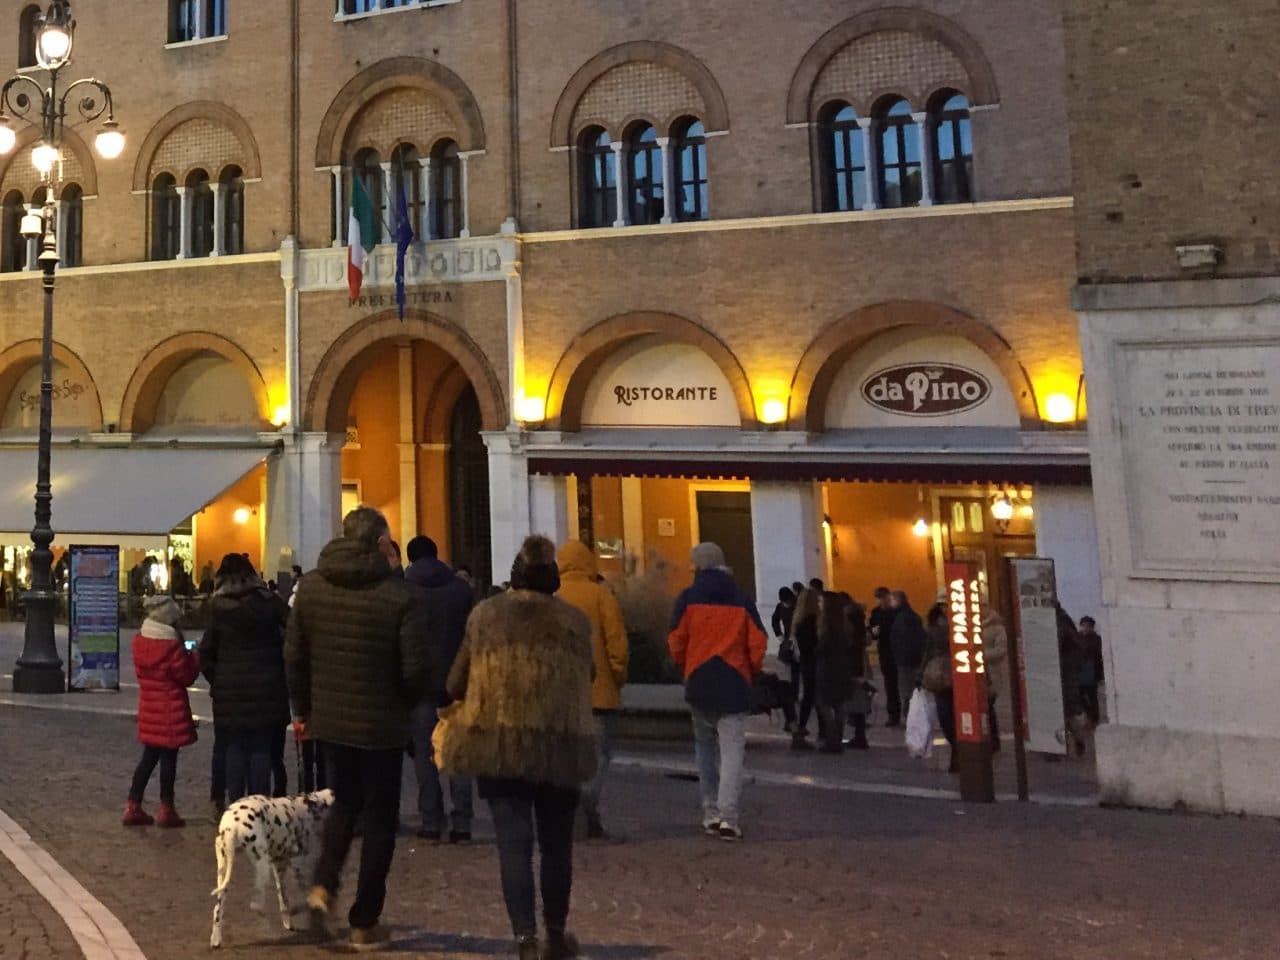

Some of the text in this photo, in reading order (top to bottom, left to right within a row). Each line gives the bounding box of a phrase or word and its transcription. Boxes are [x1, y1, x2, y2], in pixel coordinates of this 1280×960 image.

[614, 385, 717, 406] RISTORANTE
[950, 579, 970, 673] LA PIAZZA
